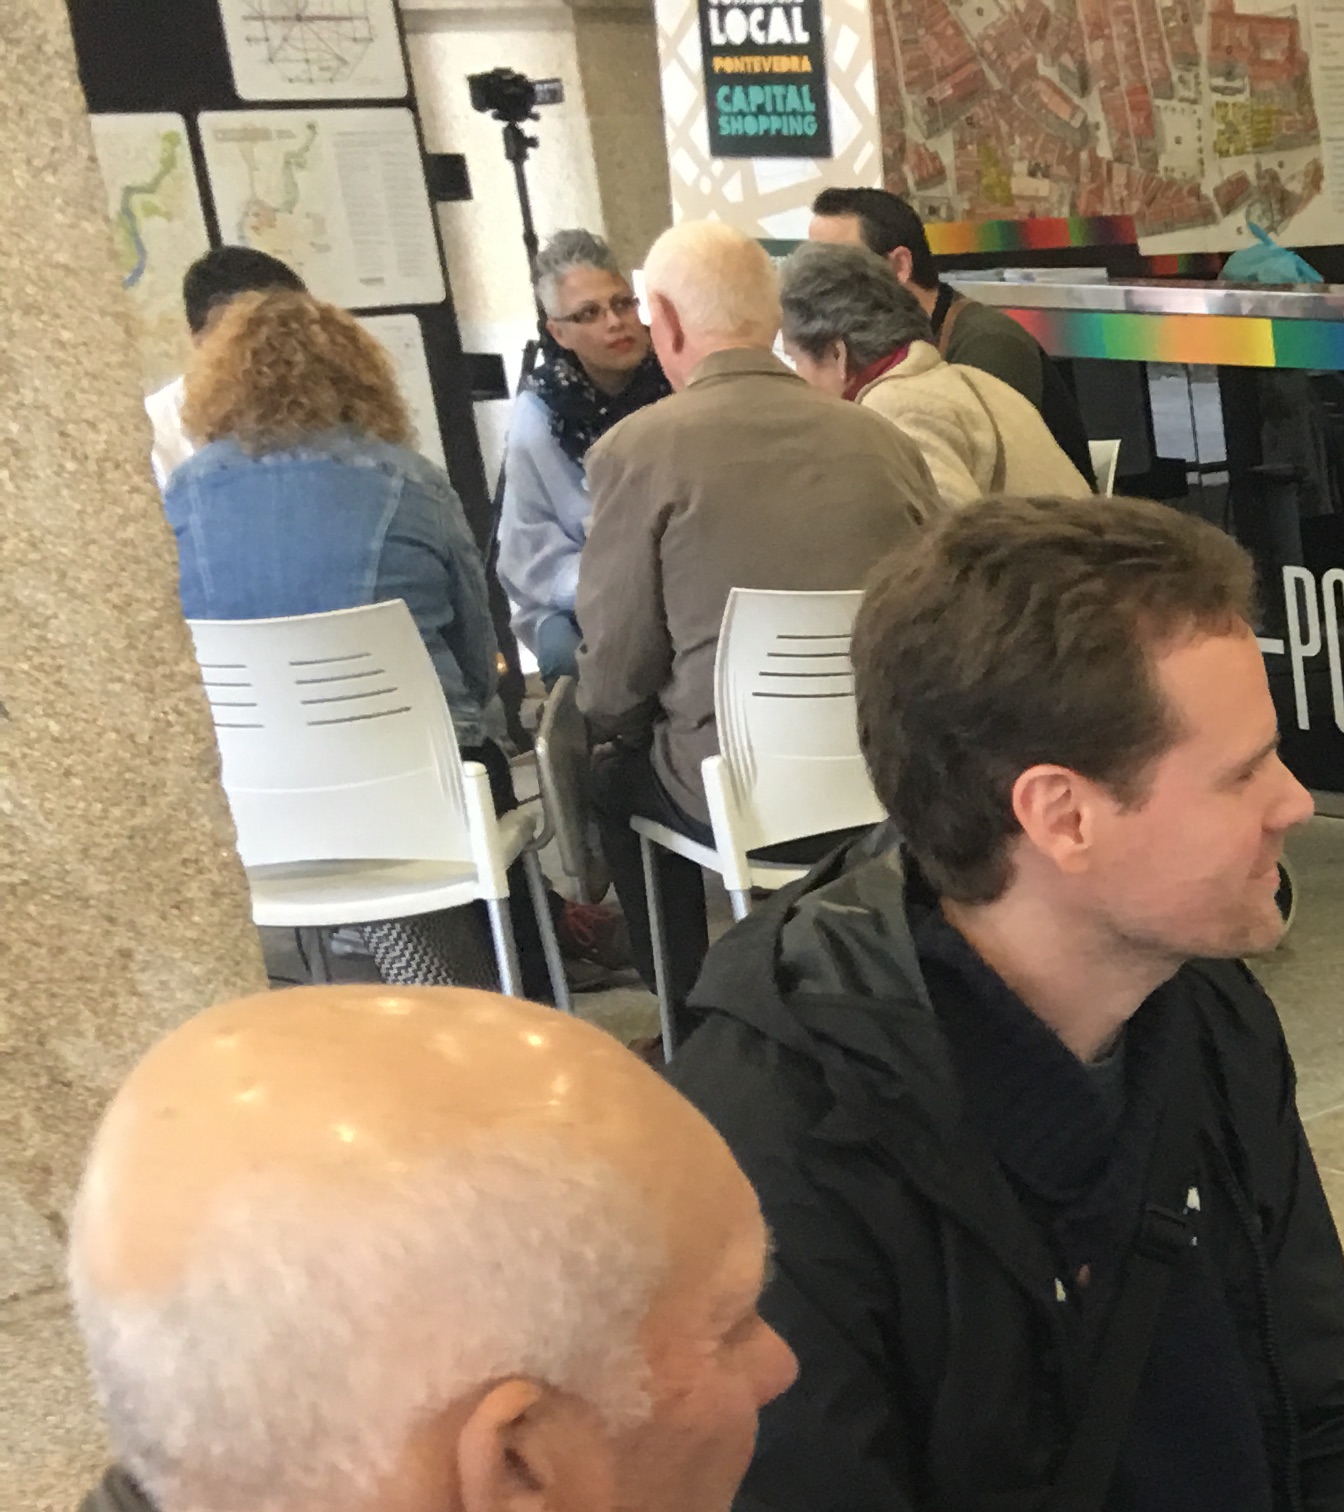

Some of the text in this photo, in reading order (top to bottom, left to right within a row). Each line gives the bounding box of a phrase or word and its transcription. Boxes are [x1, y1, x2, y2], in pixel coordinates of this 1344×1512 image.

[708, 7, 810, 46] LOCAL
[712, 55, 813, 74] PONTEVEDRA
[716, 84, 816, 113] CAPITAL
[718, 114, 818, 136] SHOPPING
